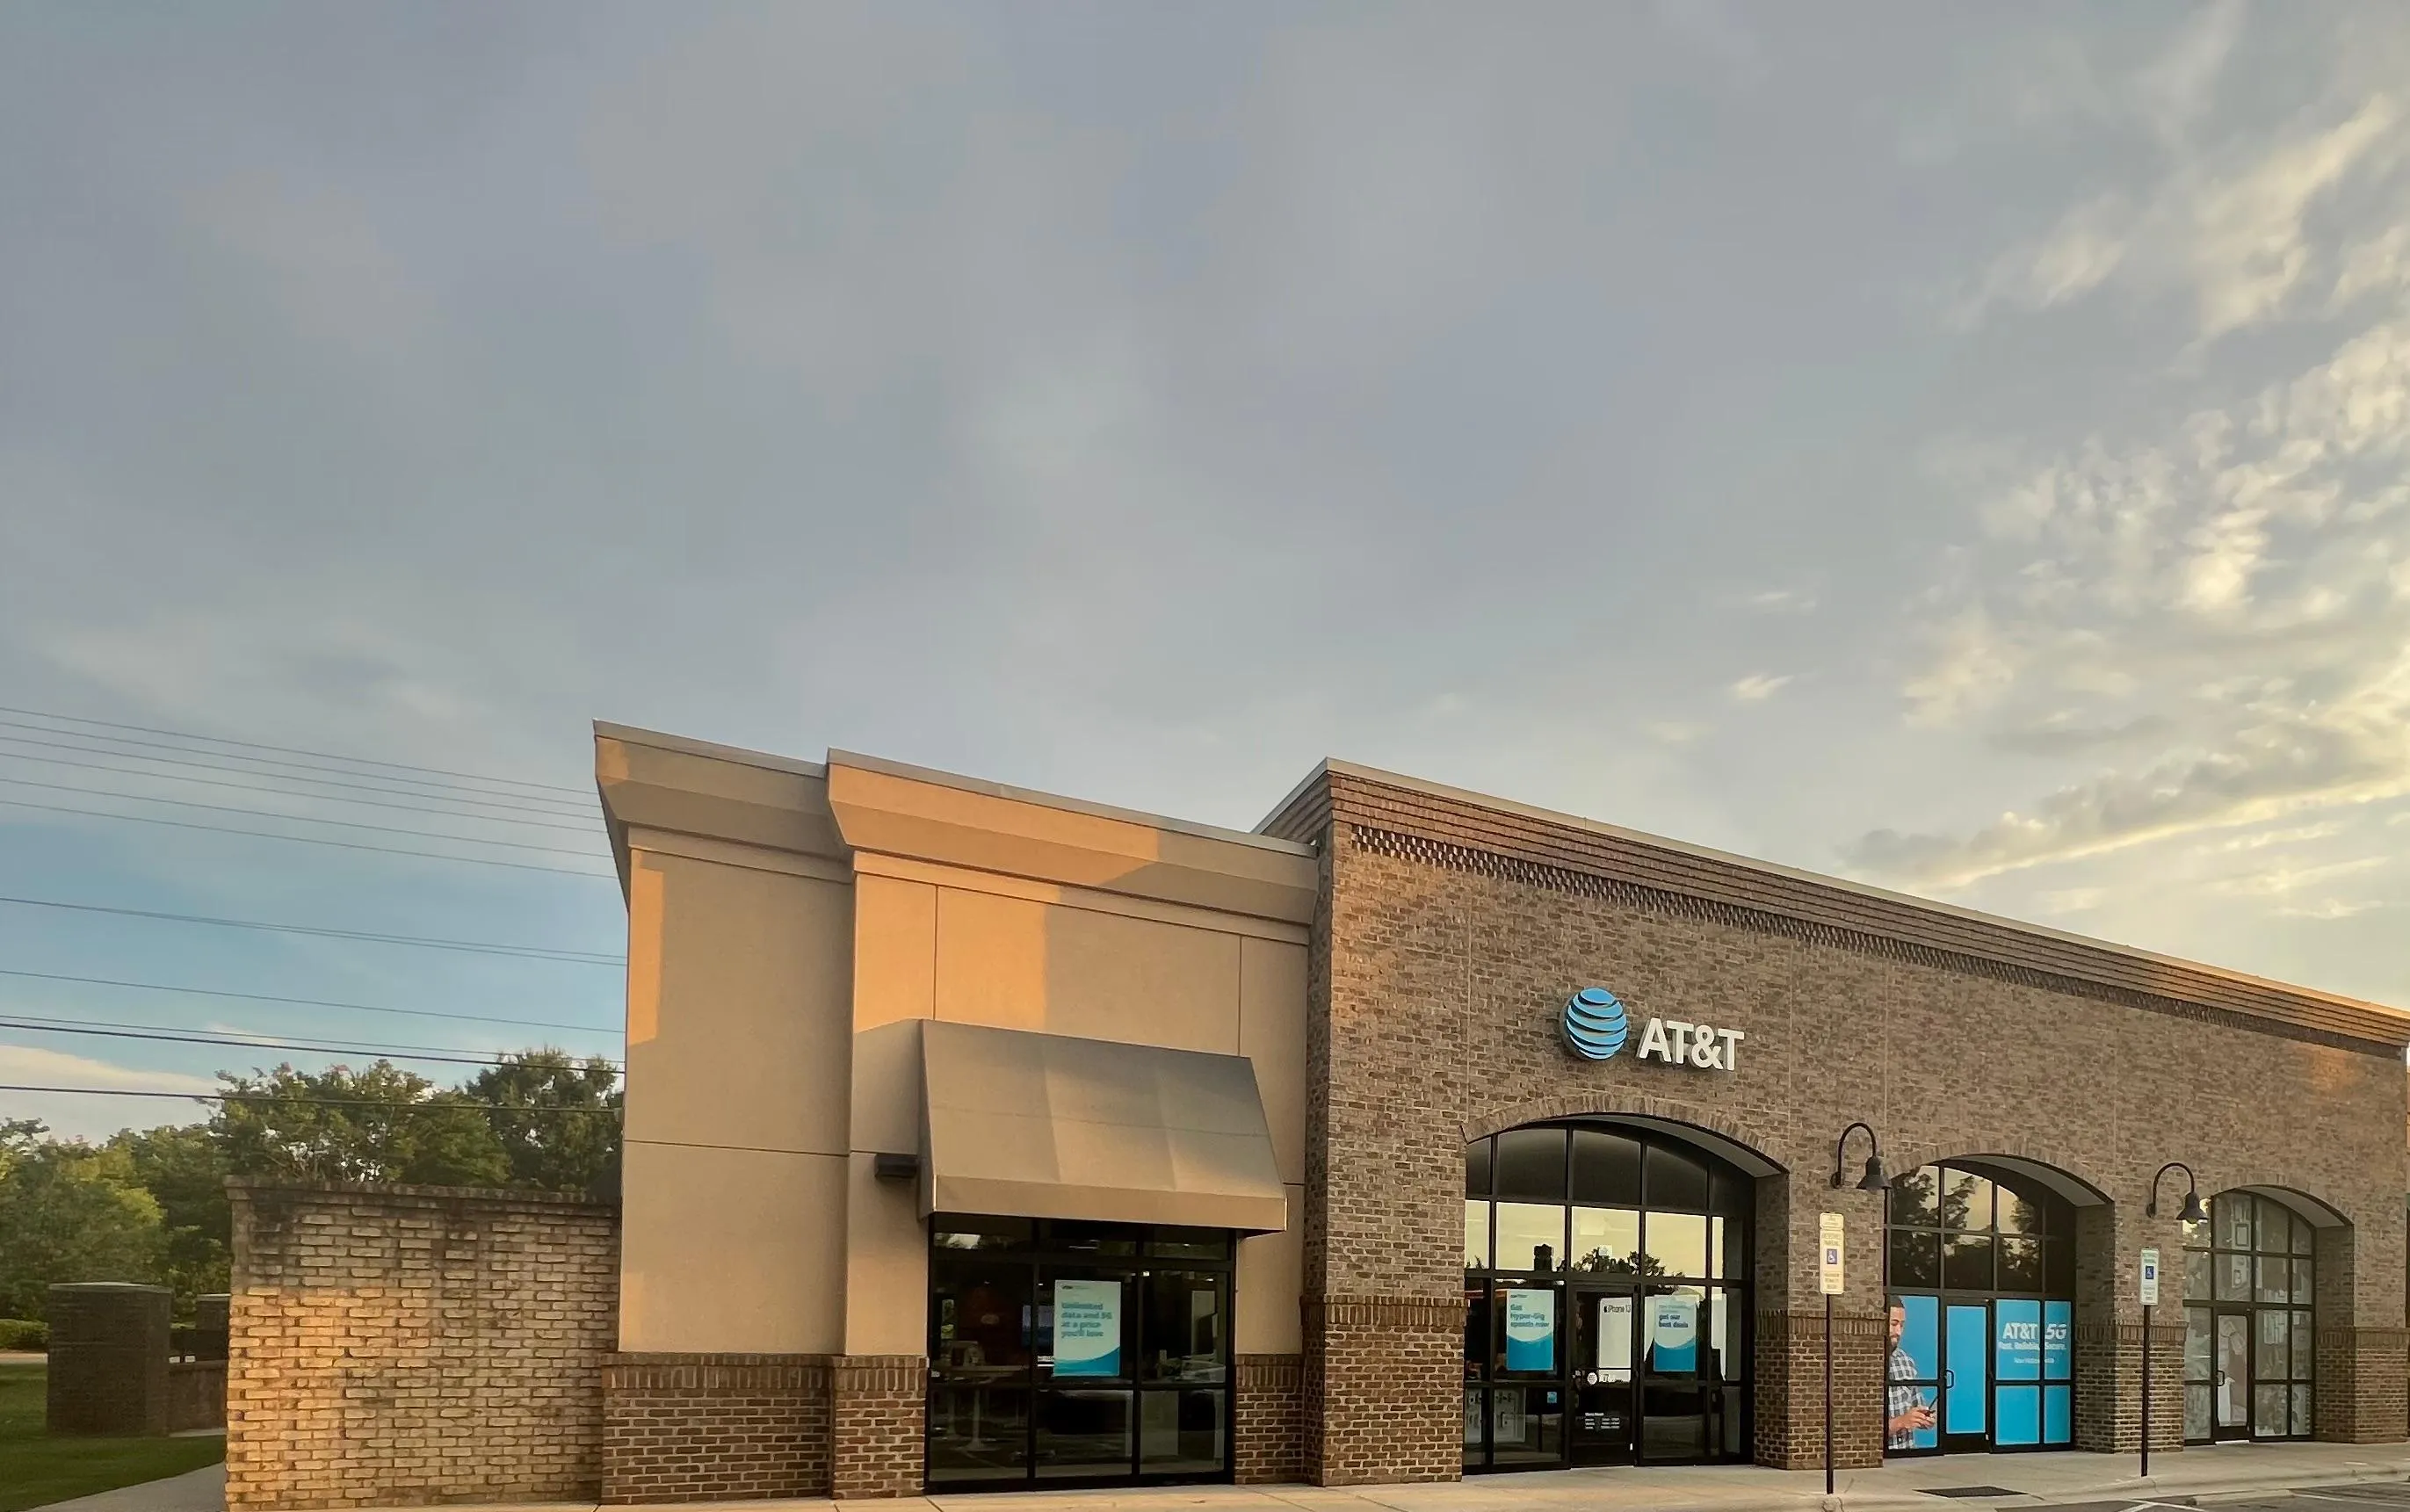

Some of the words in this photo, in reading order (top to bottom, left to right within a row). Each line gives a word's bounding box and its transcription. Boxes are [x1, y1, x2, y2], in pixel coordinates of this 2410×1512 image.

[1637, 1017, 1745, 1071] AT&T
[2002, 1322, 2038, 1340] AT&T
[2045, 1323, 2067, 1340] 5G
